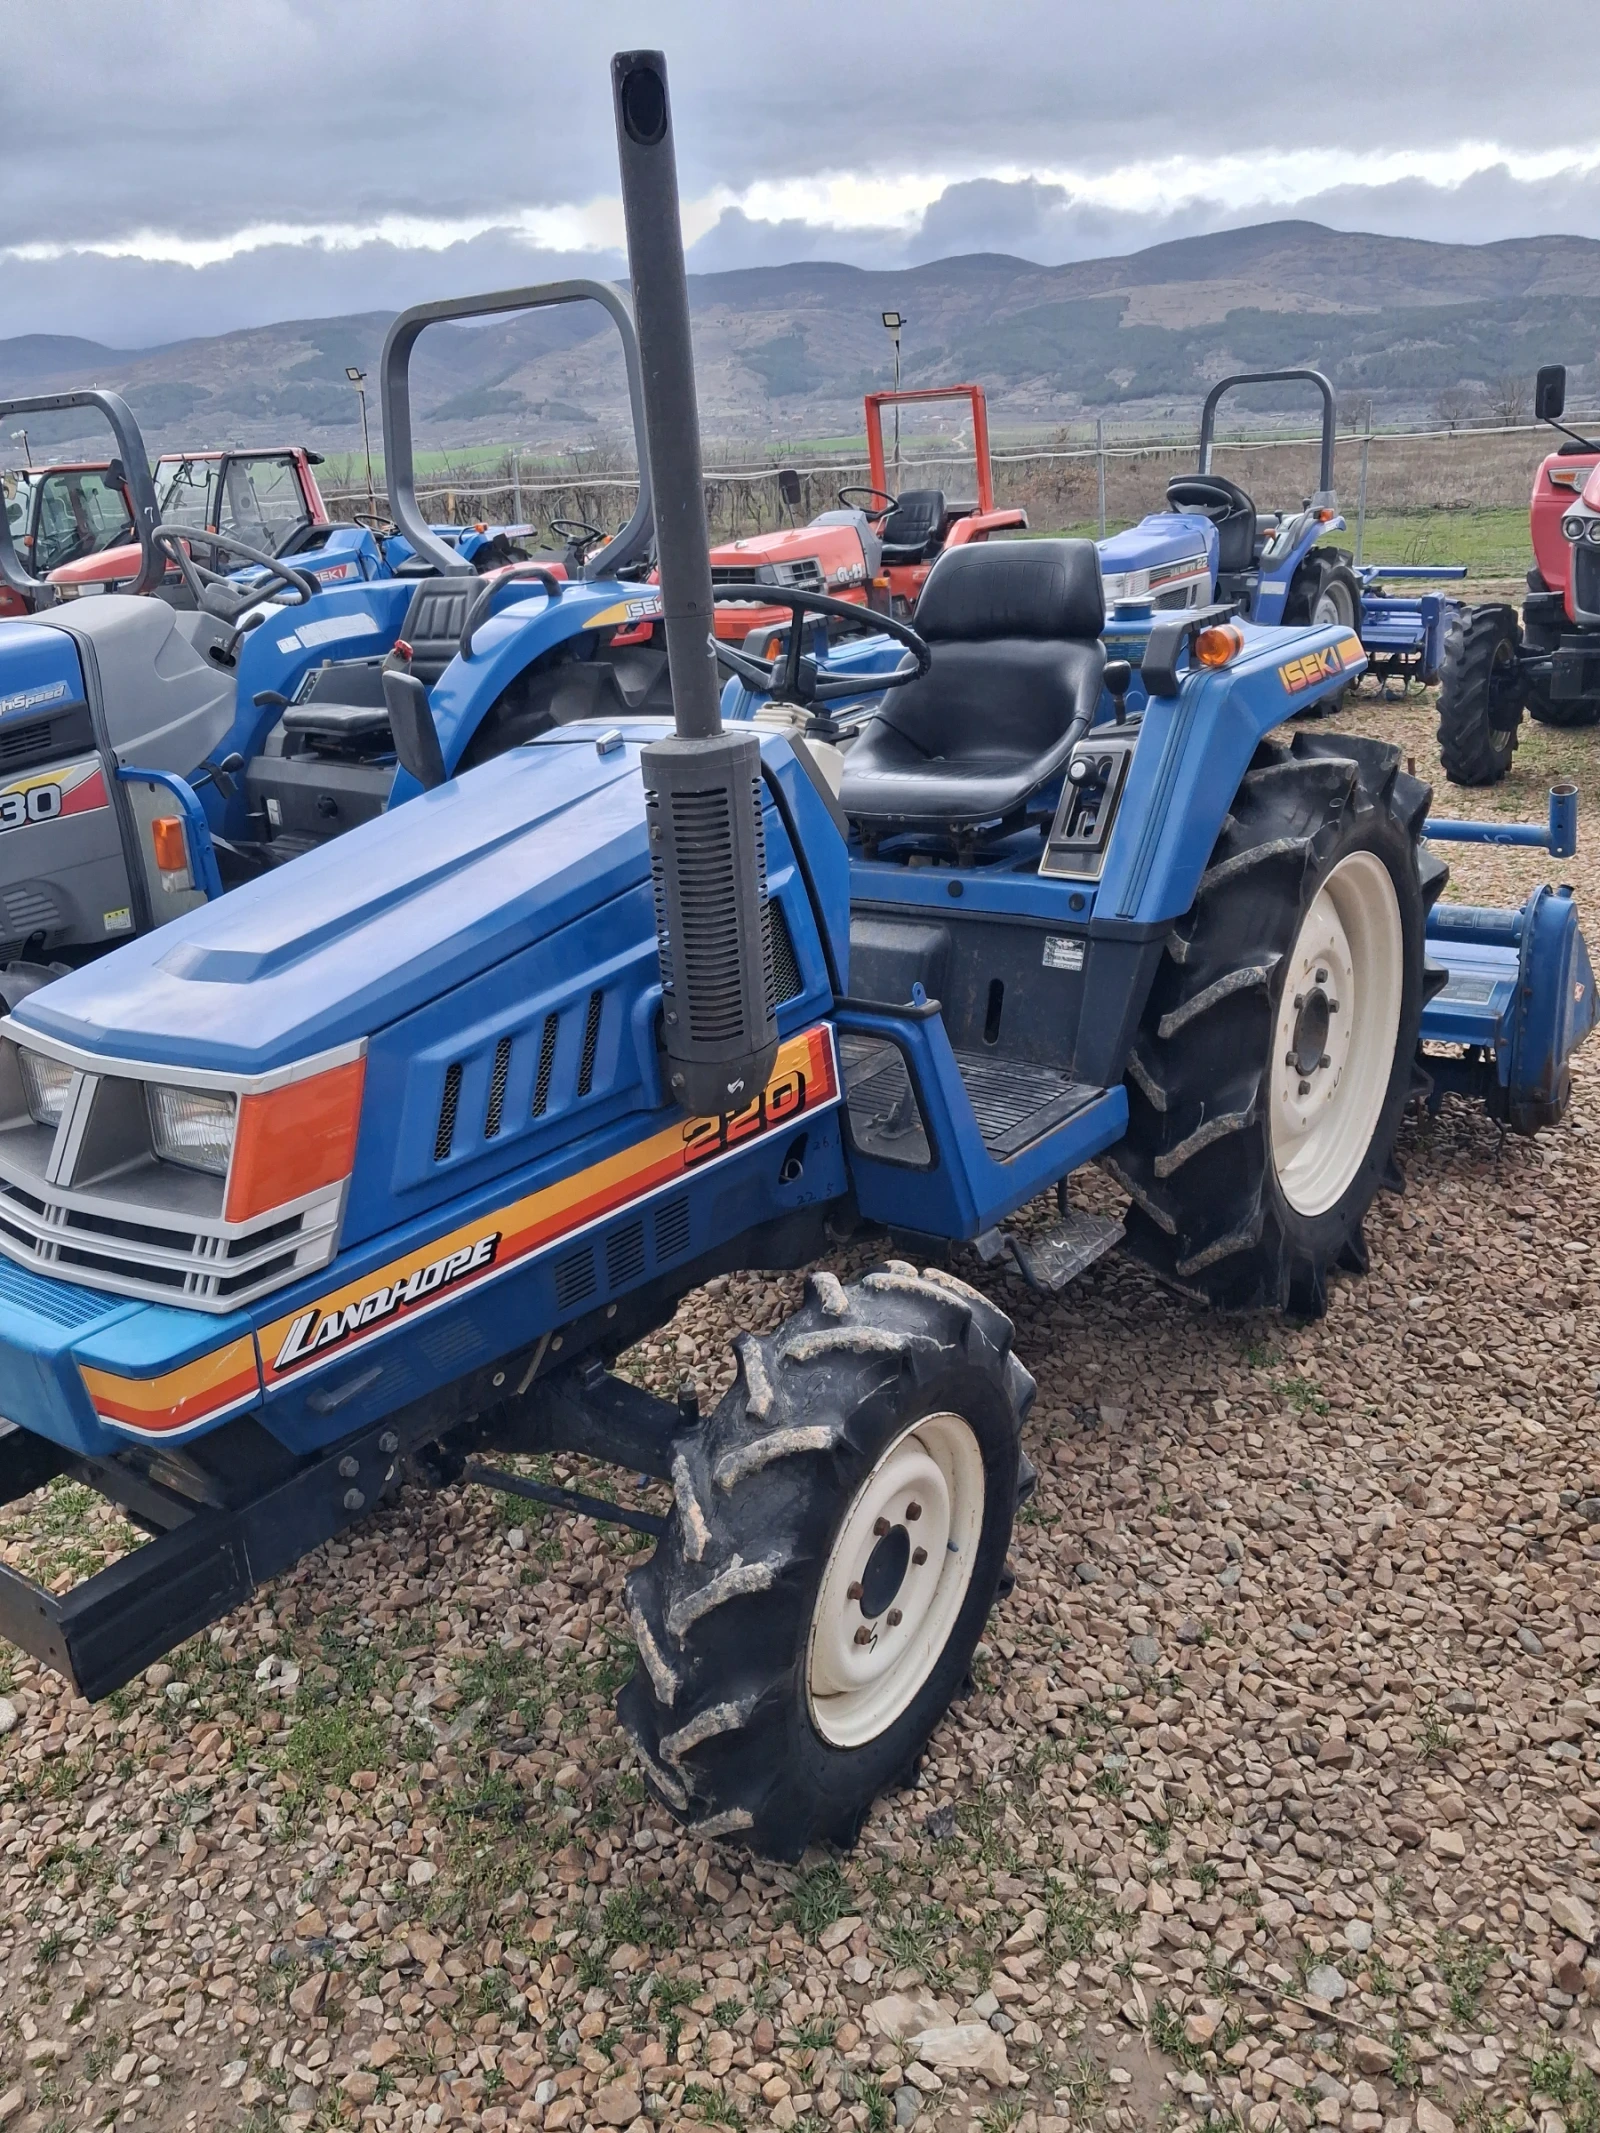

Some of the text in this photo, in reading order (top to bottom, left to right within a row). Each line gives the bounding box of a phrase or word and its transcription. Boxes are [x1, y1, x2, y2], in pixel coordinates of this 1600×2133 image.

[316, 568, 343, 581] SEKI
[625, 600, 663, 617] ISEK
[1278, 646, 1343, 695] ISEKI
